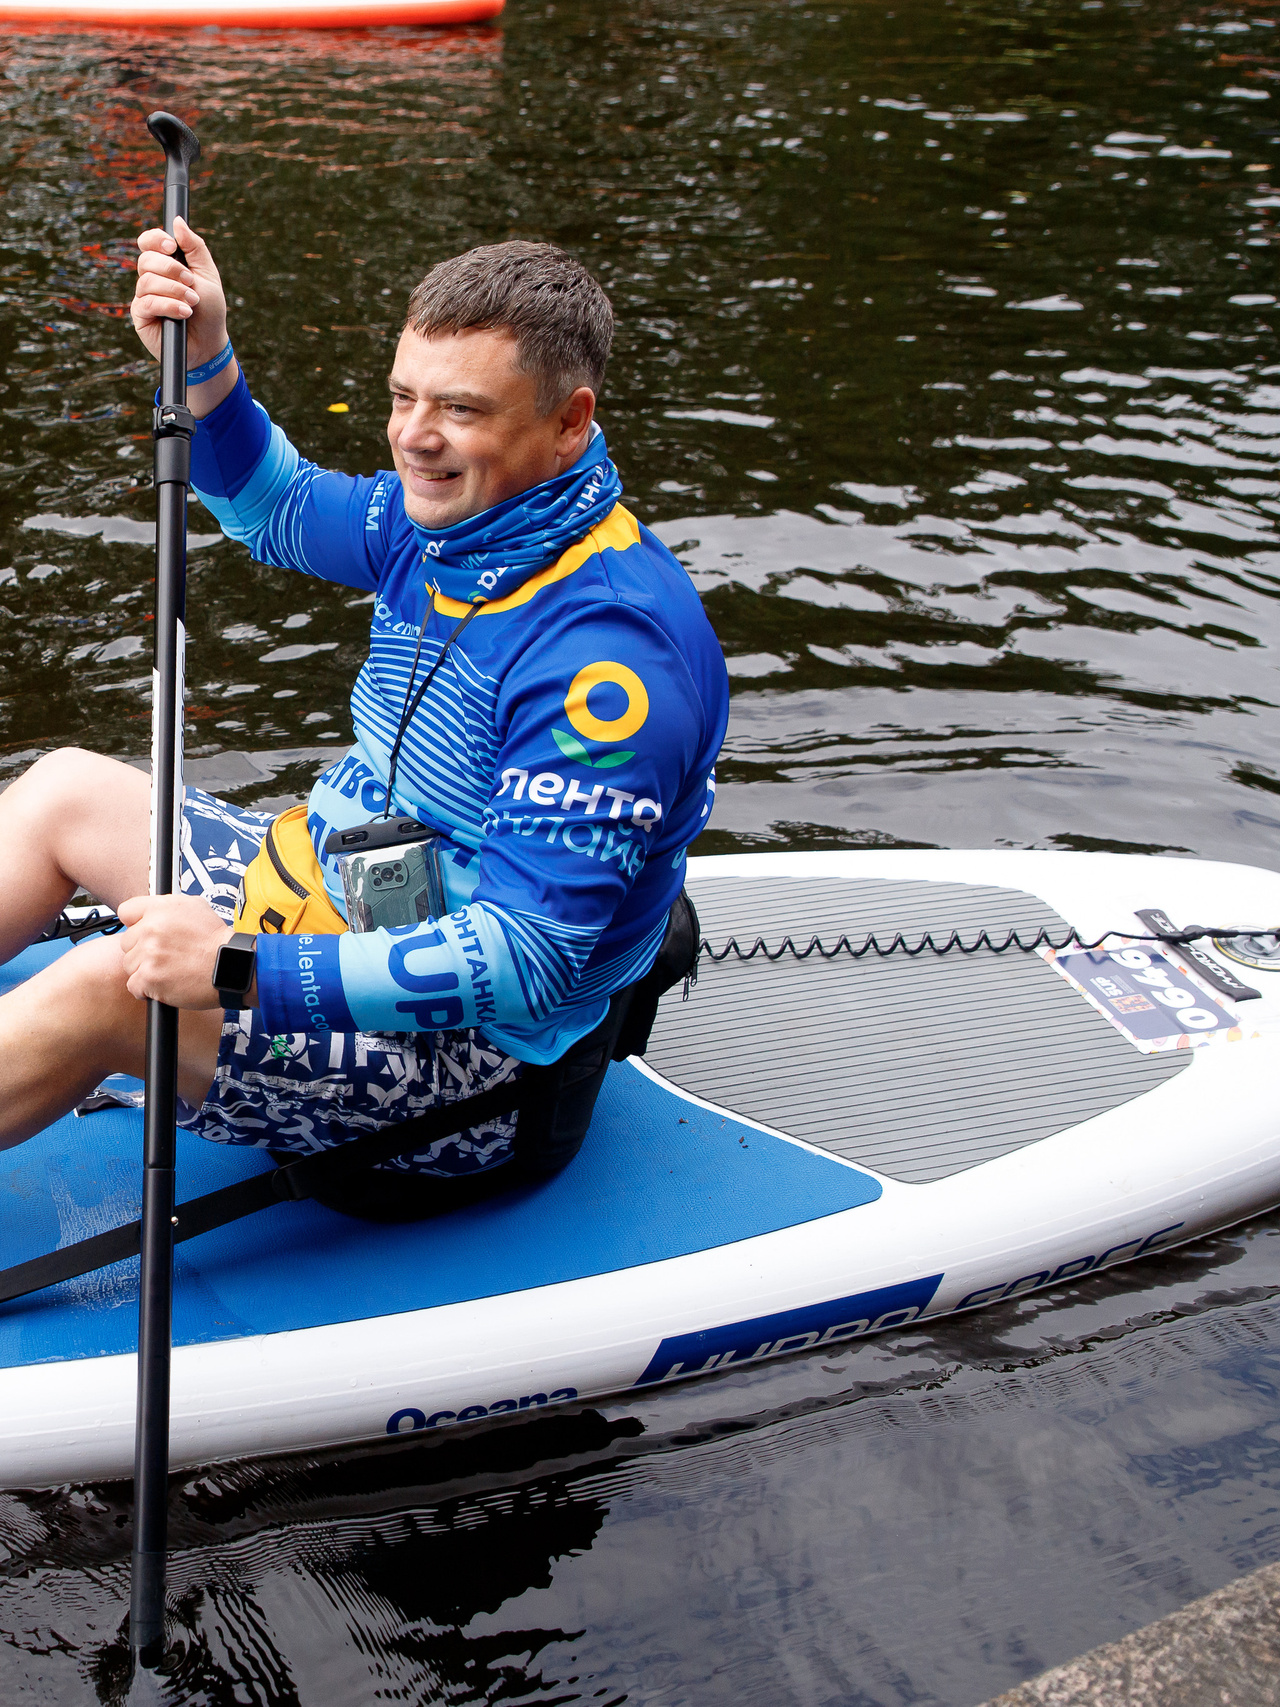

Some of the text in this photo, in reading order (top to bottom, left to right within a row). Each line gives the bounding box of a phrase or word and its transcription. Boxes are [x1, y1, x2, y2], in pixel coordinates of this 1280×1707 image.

[496, 767, 663, 833] лента
[450, 905, 498, 1024] ОНТАНКА
[1109, 949, 1220, 1030] 0646
[386, 1387, 579, 1435] Oceana
